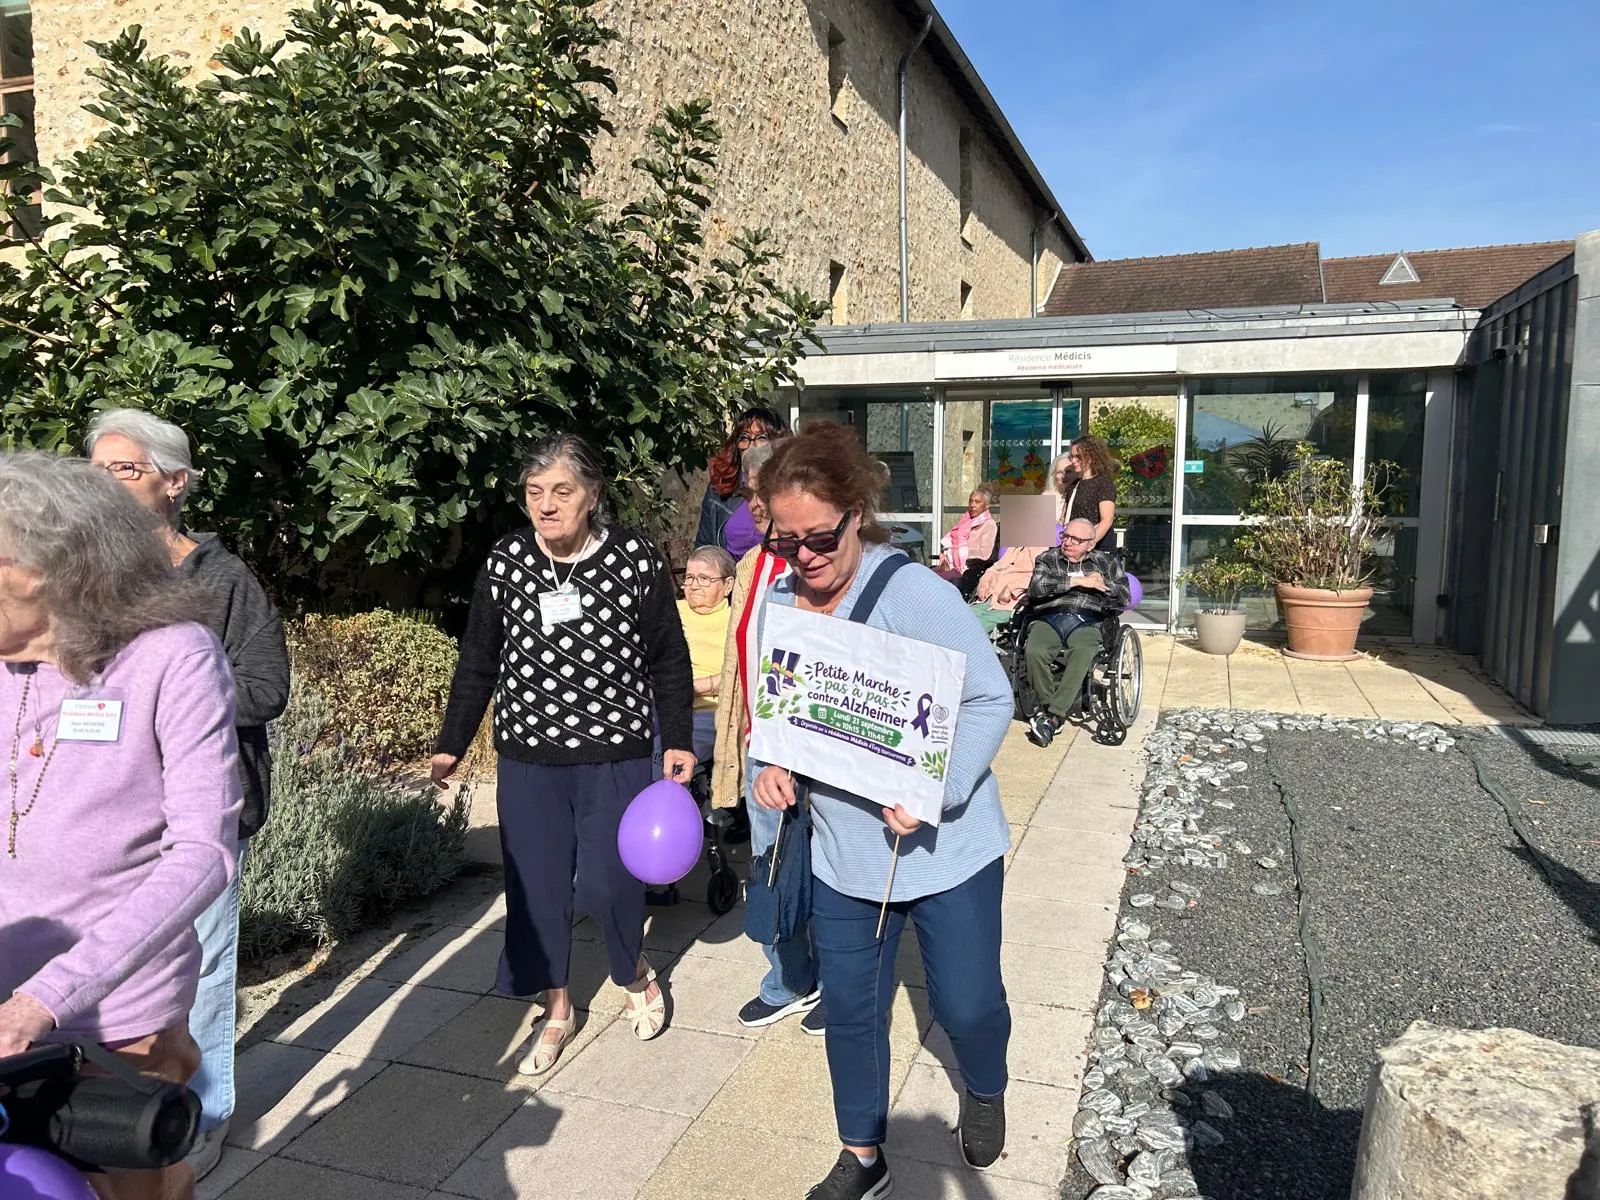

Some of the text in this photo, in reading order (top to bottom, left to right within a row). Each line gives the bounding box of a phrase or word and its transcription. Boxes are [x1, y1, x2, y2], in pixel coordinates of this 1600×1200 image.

[1008, 351, 1092, 363] Résidence Médicis
[814, 661, 901, 699] Petite Marche
[824, 680, 889, 709] pas à pas
[807, 691, 908, 728] contre Alzheimer
[833, 710, 894, 737] Lundi 21 septembre
[842, 722, 860, 733] 10h15
[867, 730, 885, 742] 11h45
